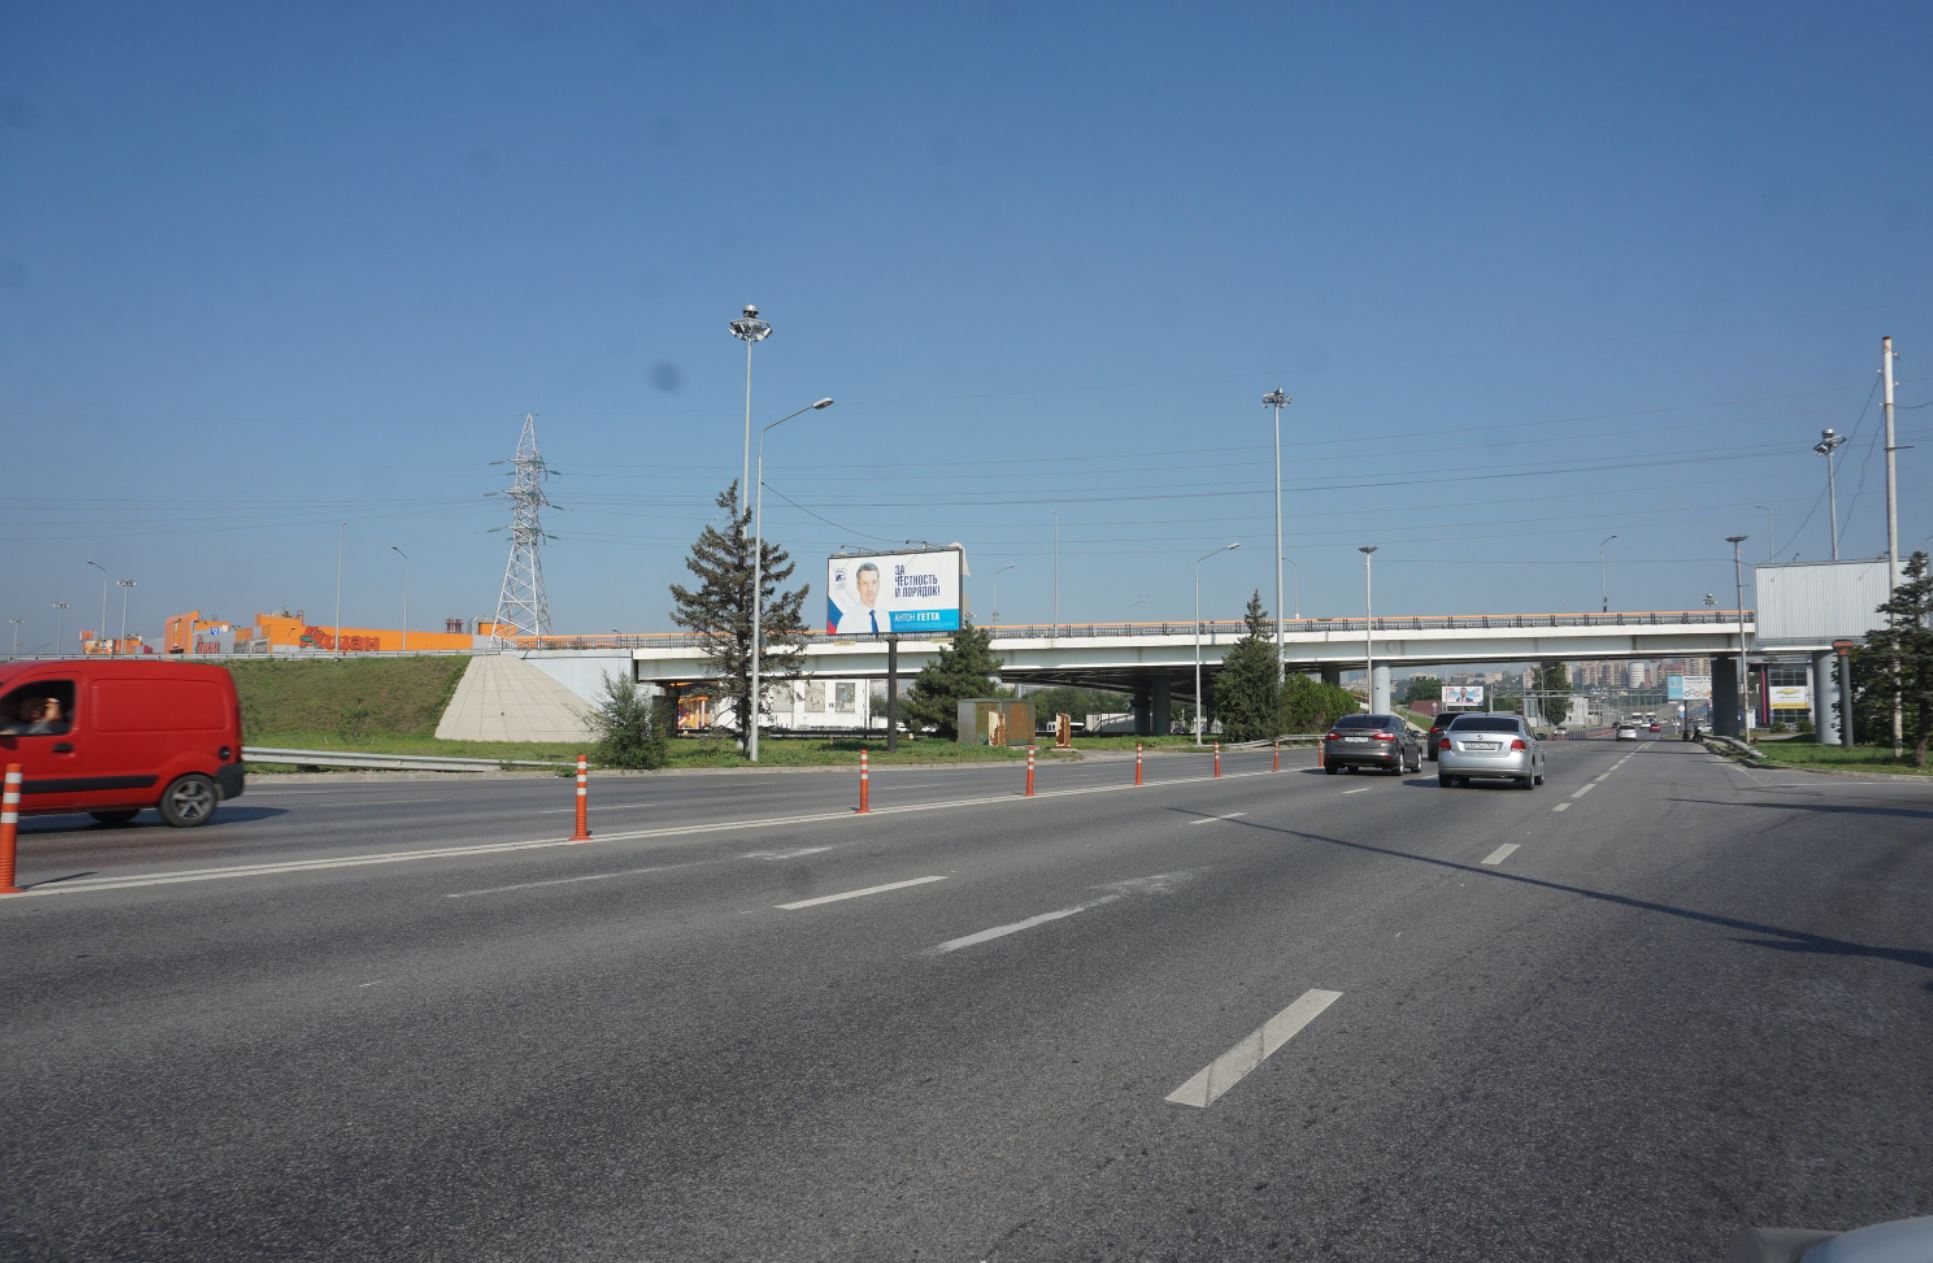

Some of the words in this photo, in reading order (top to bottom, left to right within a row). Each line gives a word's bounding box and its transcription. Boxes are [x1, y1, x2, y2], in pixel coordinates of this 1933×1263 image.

[895, 565, 905, 575] ЗА
[895, 574, 938, 586] ЧЕСТНОСТЬ
[895, 587, 901, 597] И
[903, 585, 940, 598] ПОРЯДОК!
[895, 613, 915, 622] АНТОН
[916, 612, 940, 622] ГЕТТА
